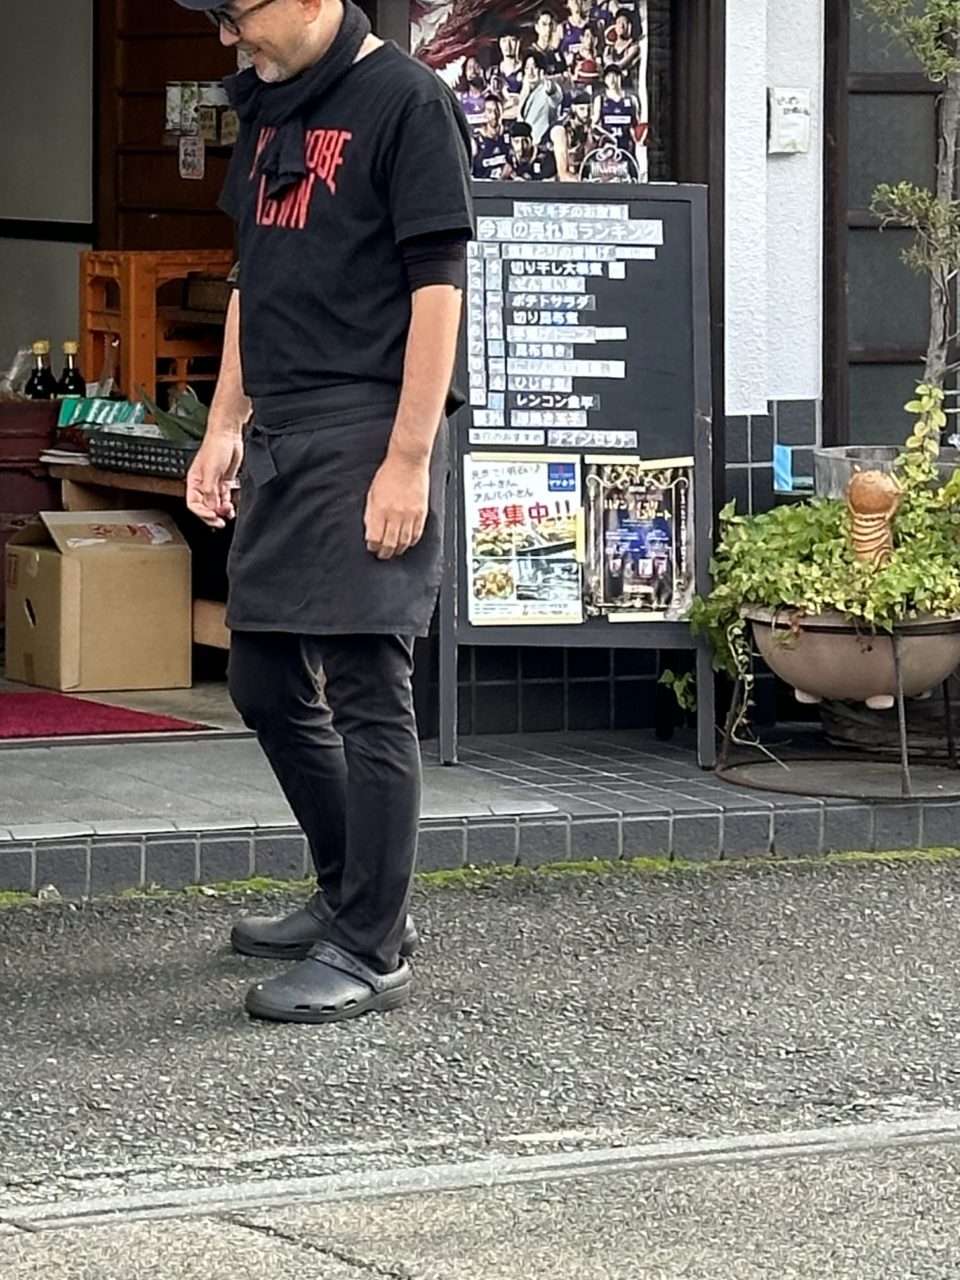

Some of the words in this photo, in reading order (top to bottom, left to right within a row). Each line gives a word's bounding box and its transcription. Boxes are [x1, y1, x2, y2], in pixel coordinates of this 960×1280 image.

[478, 220, 659, 240] 今週の売れ筋ランキング
[511, 295, 590, 310] ポテトサラダ
[516, 395, 594, 409] レンコン金平
[478, 500, 571, 530] 募集中!!
